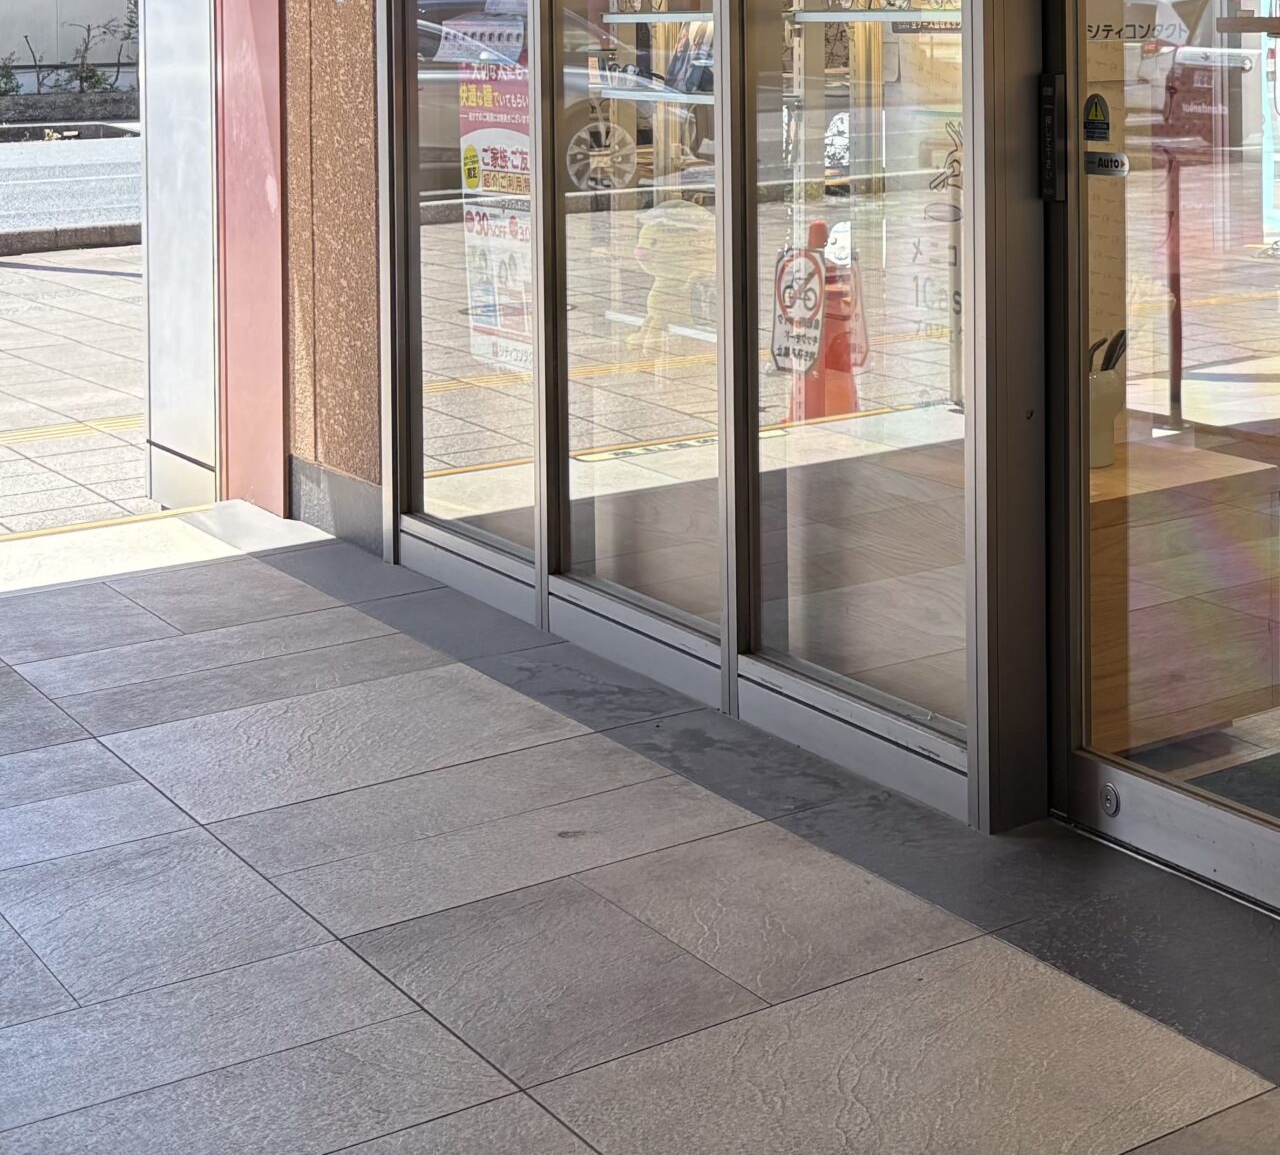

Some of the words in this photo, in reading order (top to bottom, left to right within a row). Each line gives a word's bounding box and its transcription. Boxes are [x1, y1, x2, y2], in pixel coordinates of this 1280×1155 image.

[1087, 23, 1187, 39] シティコンタクト
[1097, 156, 1120, 169] Auto
